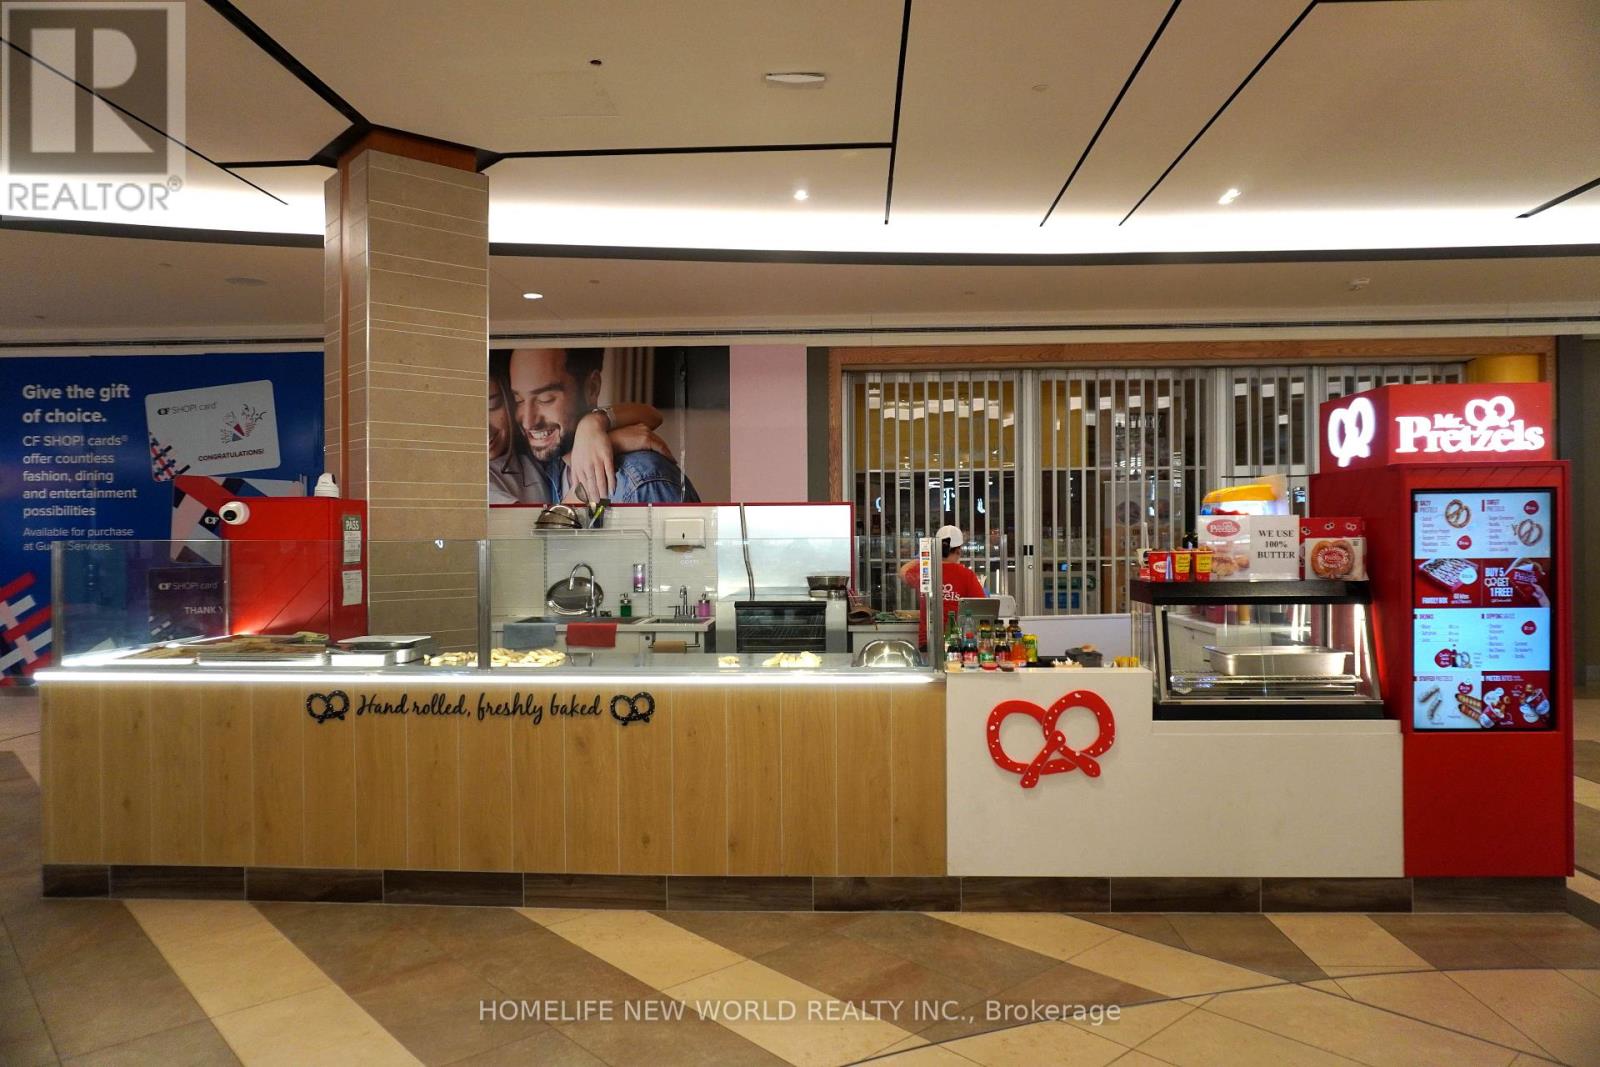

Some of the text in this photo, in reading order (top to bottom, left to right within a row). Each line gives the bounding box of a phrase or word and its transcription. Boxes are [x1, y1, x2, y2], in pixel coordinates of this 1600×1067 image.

[22, 384, 131, 402] Give the gift
[22, 409, 107, 423] of choice.
[1395, 416, 1545, 453] Pretzels
[22, 435, 41, 447] CF
[43, 435, 84, 446] SHOP!
[22, 452, 115, 464] offer countless
[198, 448, 265, 462] CONGRATULATIONS!
[22, 470, 114, 483] fashion, dining
[22, 488, 138, 499] and entertainment
[23, 505, 96, 519] possibilities
[345, 520, 360, 531] PASS
[22, 527, 135, 538] Available for purchase
[1258, 529, 1295, 538] WE USE
[23, 543, 34, 551] at
[1265, 540, 1288, 549] 100%
[1257, 551, 1296, 559] BUTTER
[184, 606, 216, 614] THANK
[356, 692, 602, 726] Hand rolled, freshly baked
